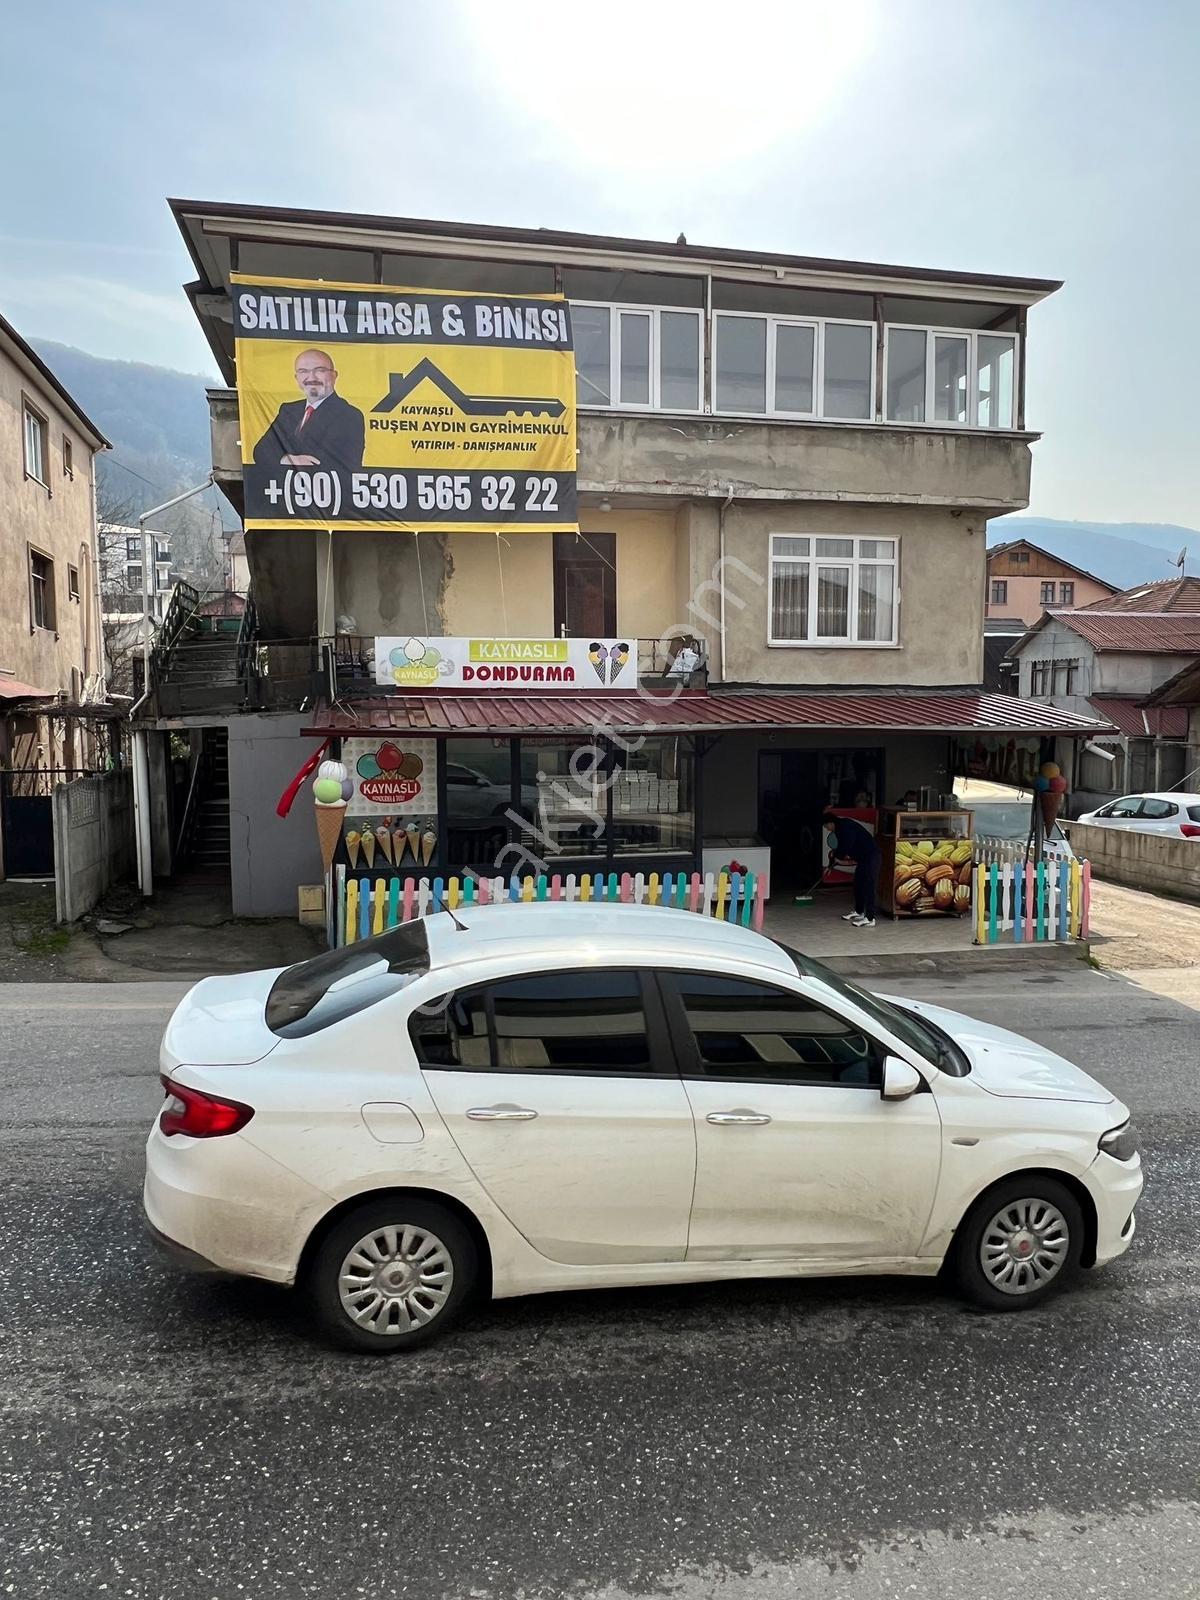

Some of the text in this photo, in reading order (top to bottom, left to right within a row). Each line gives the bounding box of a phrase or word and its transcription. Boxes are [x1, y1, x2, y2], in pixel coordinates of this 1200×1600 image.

[239, 293, 350, 334] SATILIK
[356, 300, 432, 336] ARSA
[442, 304, 466, 337] &
[401, 405, 454, 417] KAYNAŞLI
[369, 419, 569, 435] RUŞEN AYDIN GAYRİMENKUL
[411, 440, 455, 453] YATIRIM
[463, 441, 537, 453] DANIŞMANLIK
[264, 469, 559, 516] +(90) 530 565 32 22
[479, 643, 558, 658] KAYNASLI
[462, 666, 575, 682] DONDURMA
[363, 783, 418, 795] KAYNASLI
